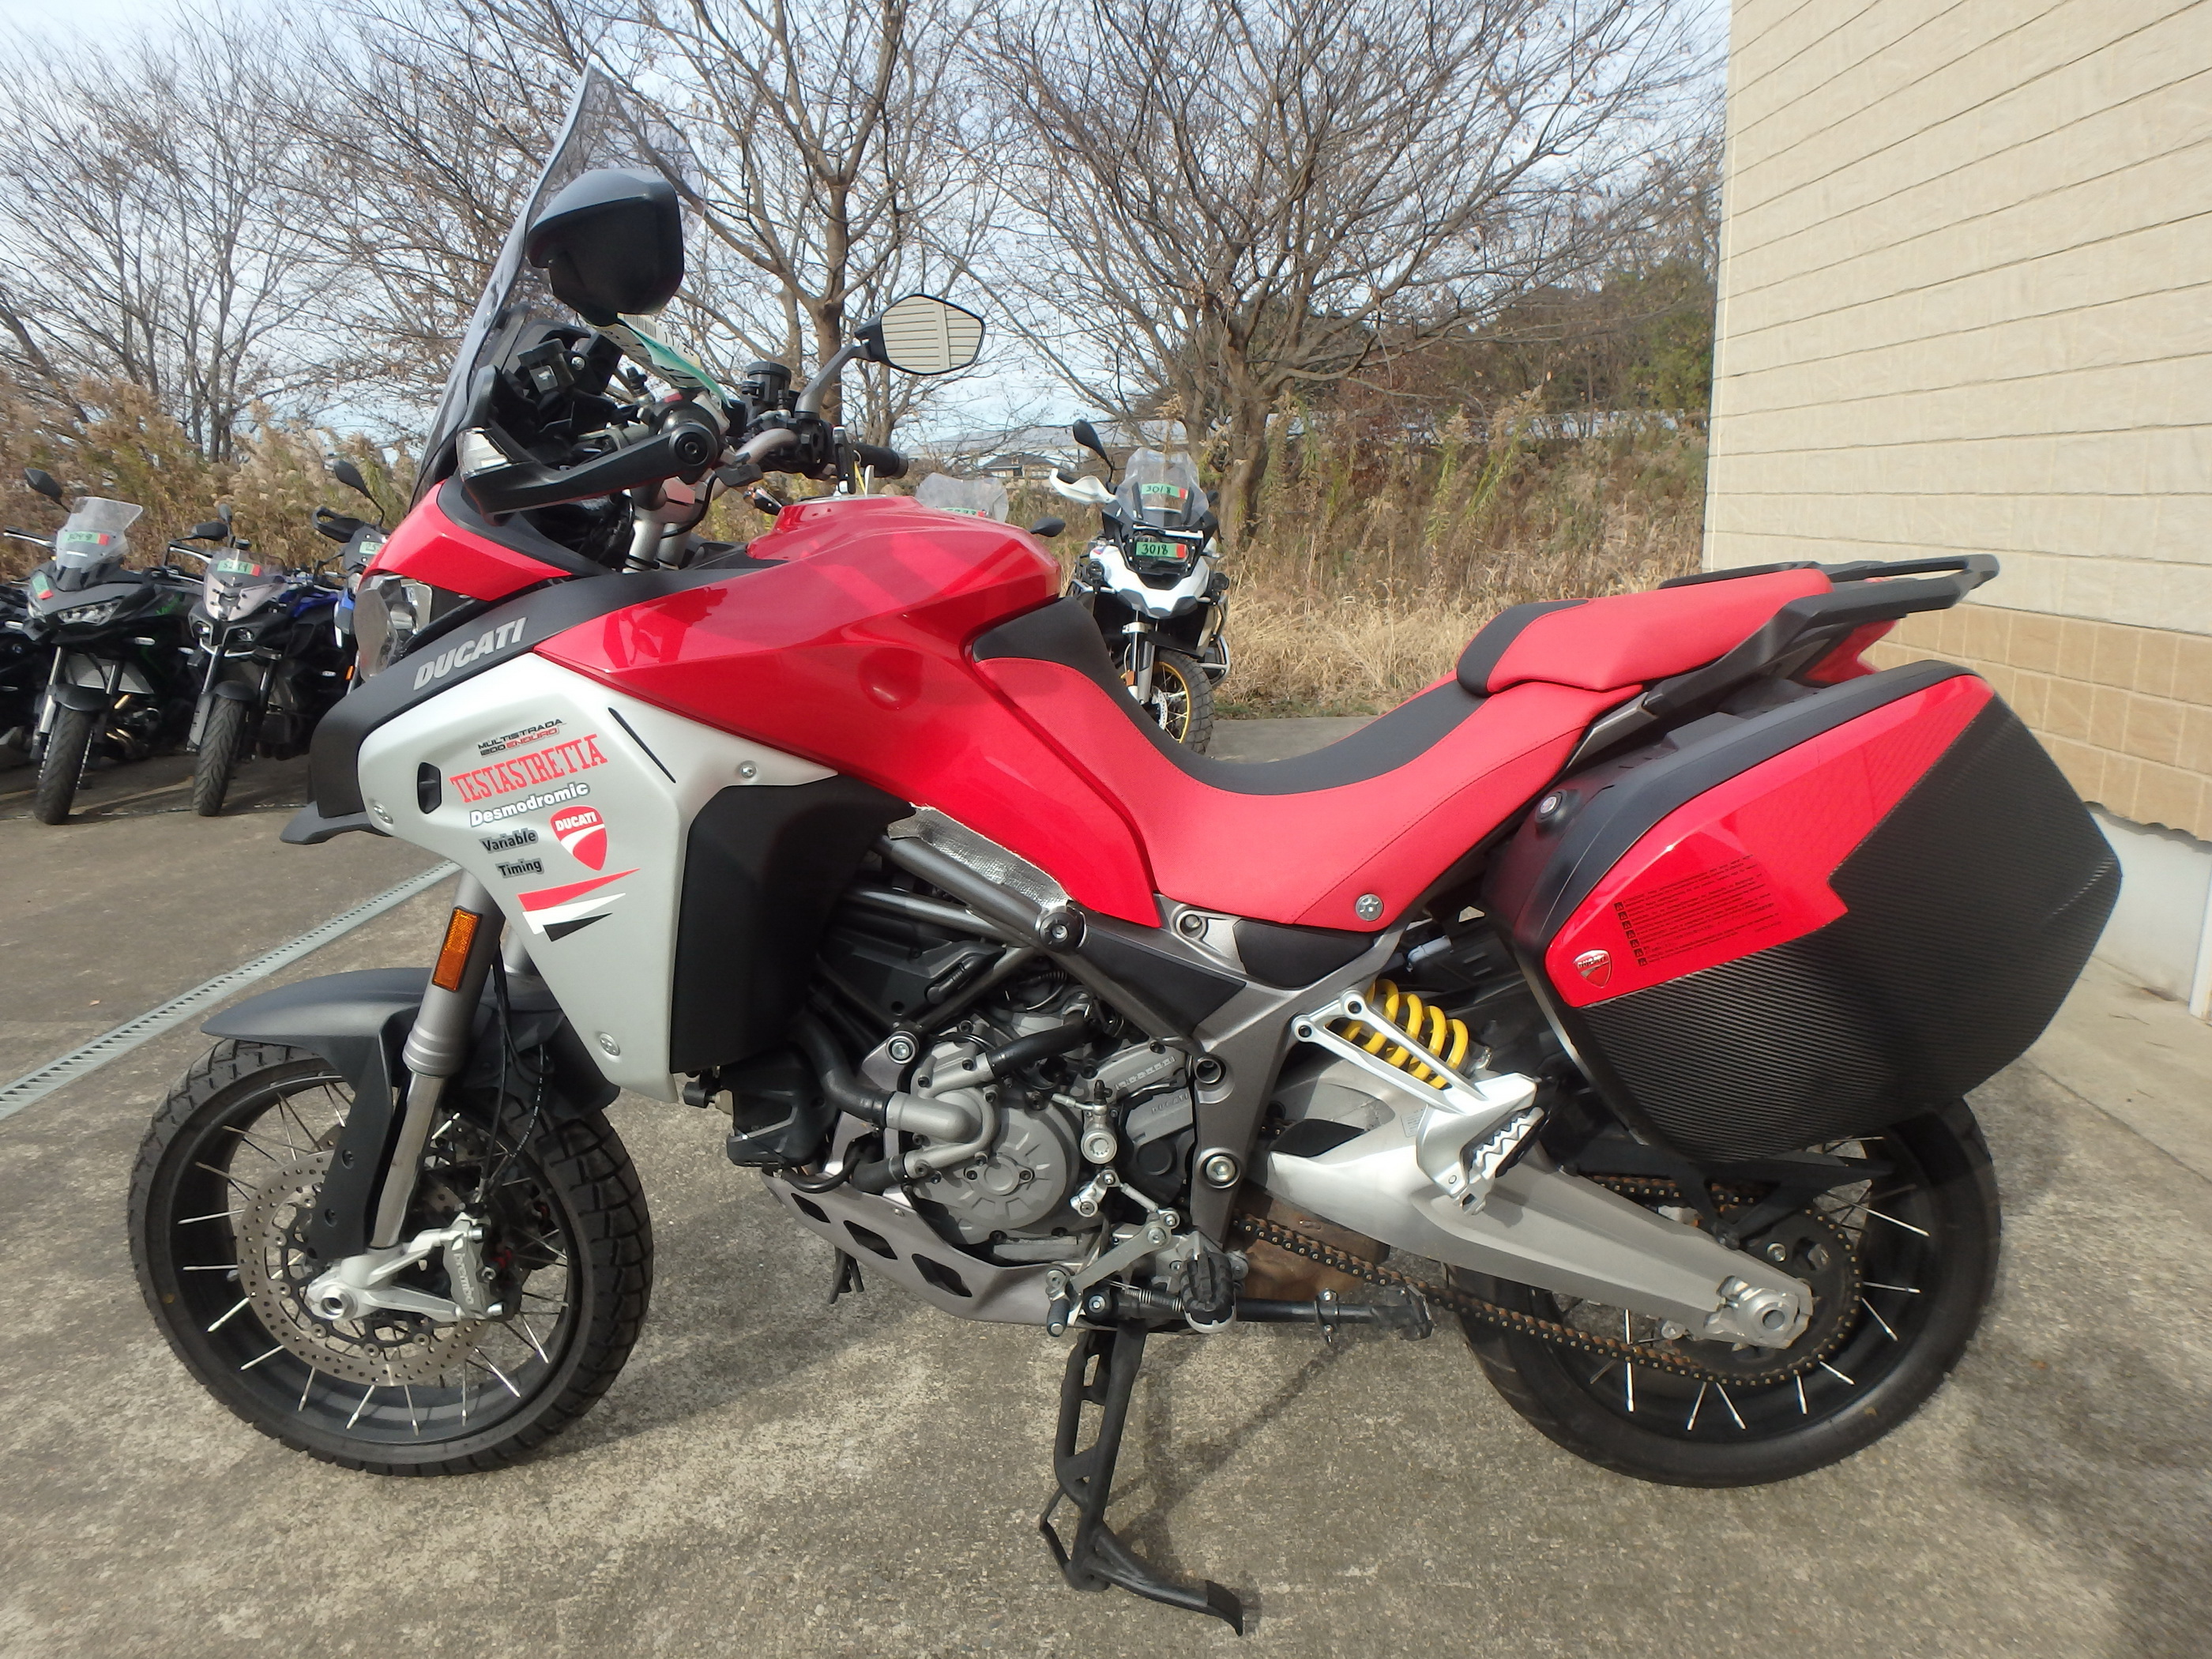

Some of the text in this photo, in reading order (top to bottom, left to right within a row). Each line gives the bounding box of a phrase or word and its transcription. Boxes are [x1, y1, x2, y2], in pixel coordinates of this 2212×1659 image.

[1142, 544, 1168, 555] 3018
[413, 616, 528, 691] DUCATI
[478, 718, 563, 750] MULTISTRADA
[480, 726, 559, 757] 1200 ENDURO
[449, 733, 608, 803] TESTASTRETTA
[470, 782, 590, 826] Desmodromic
[555, 811, 597, 832] DUCATI
[481, 830, 537, 852] Variable
[497, 858, 543, 878] Timing
[453, 1253, 475, 1305] brembo
